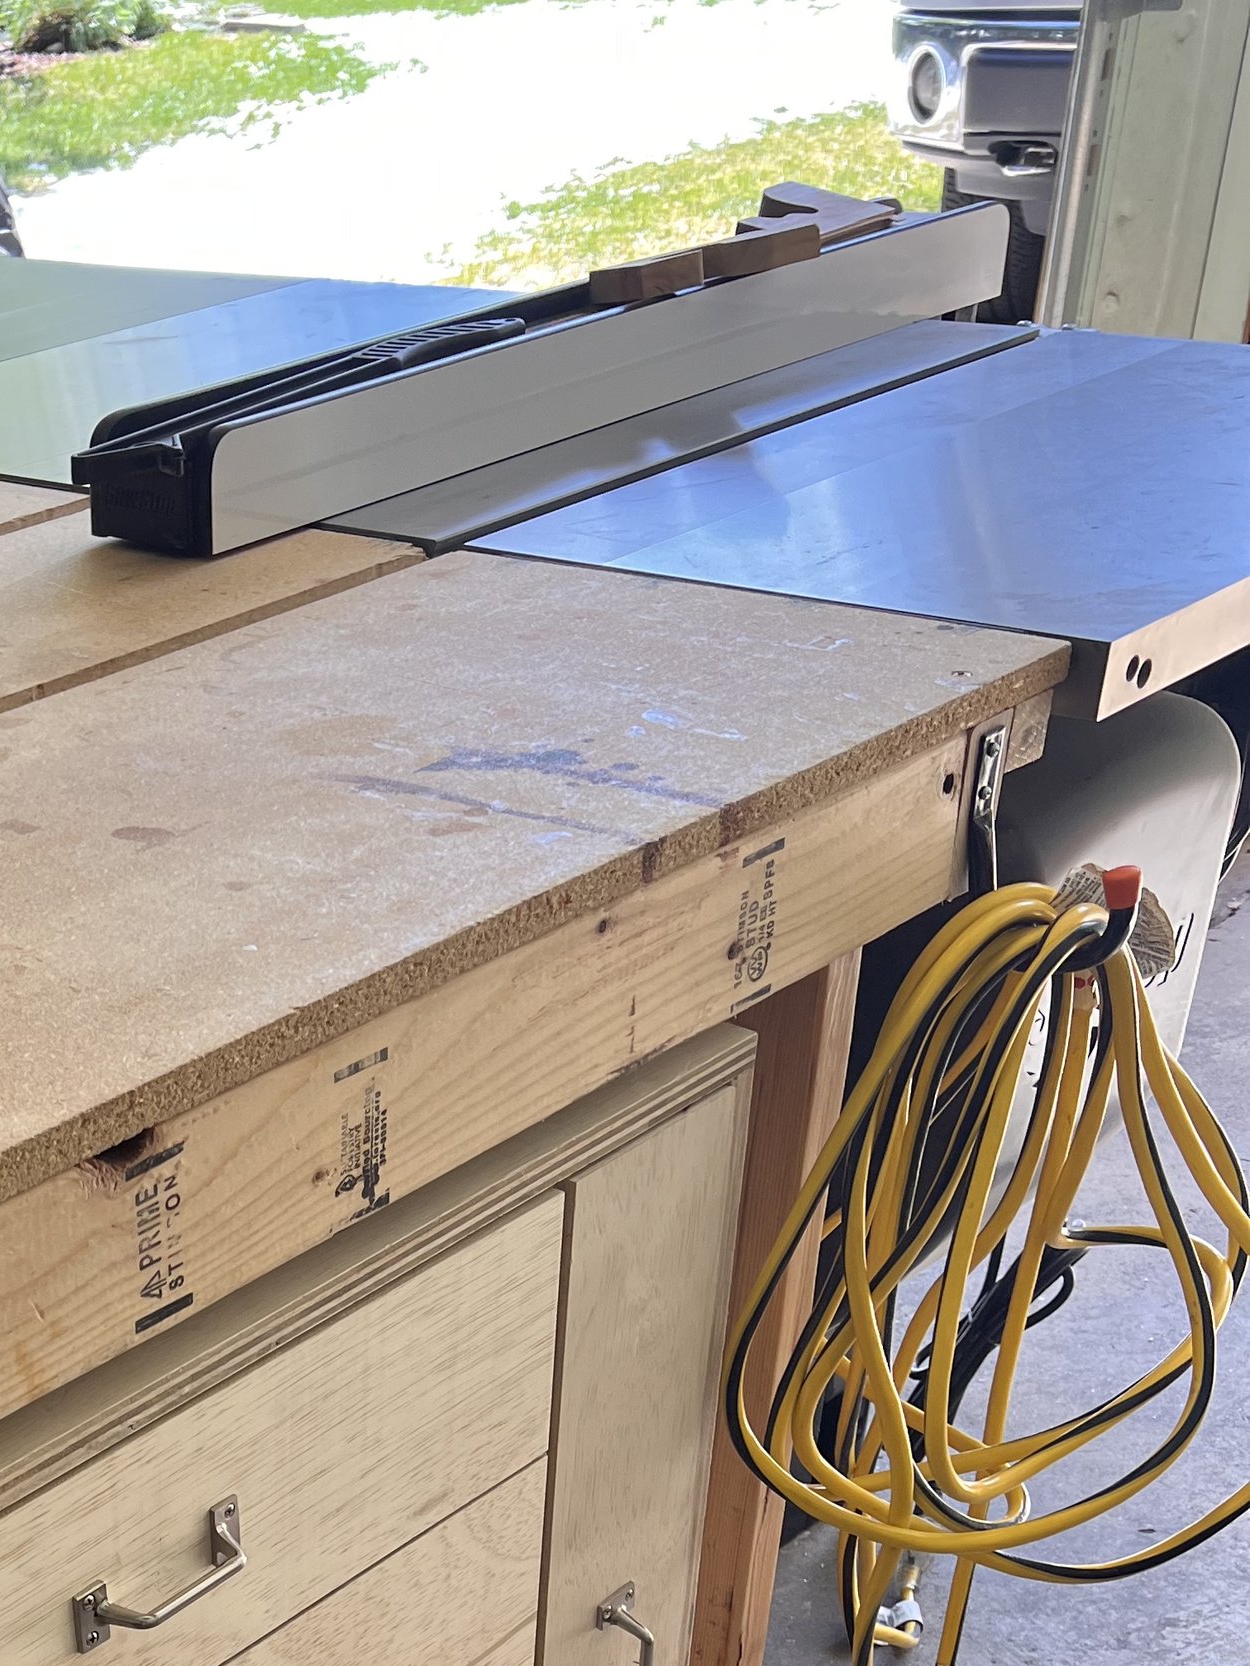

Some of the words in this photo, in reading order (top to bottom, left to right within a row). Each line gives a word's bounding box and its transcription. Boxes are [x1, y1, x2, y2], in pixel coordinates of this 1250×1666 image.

[745, 900, 760, 949] STUD
[135, 1183, 163, 1272] PRIME
[163, 1174, 185, 1291] STION
